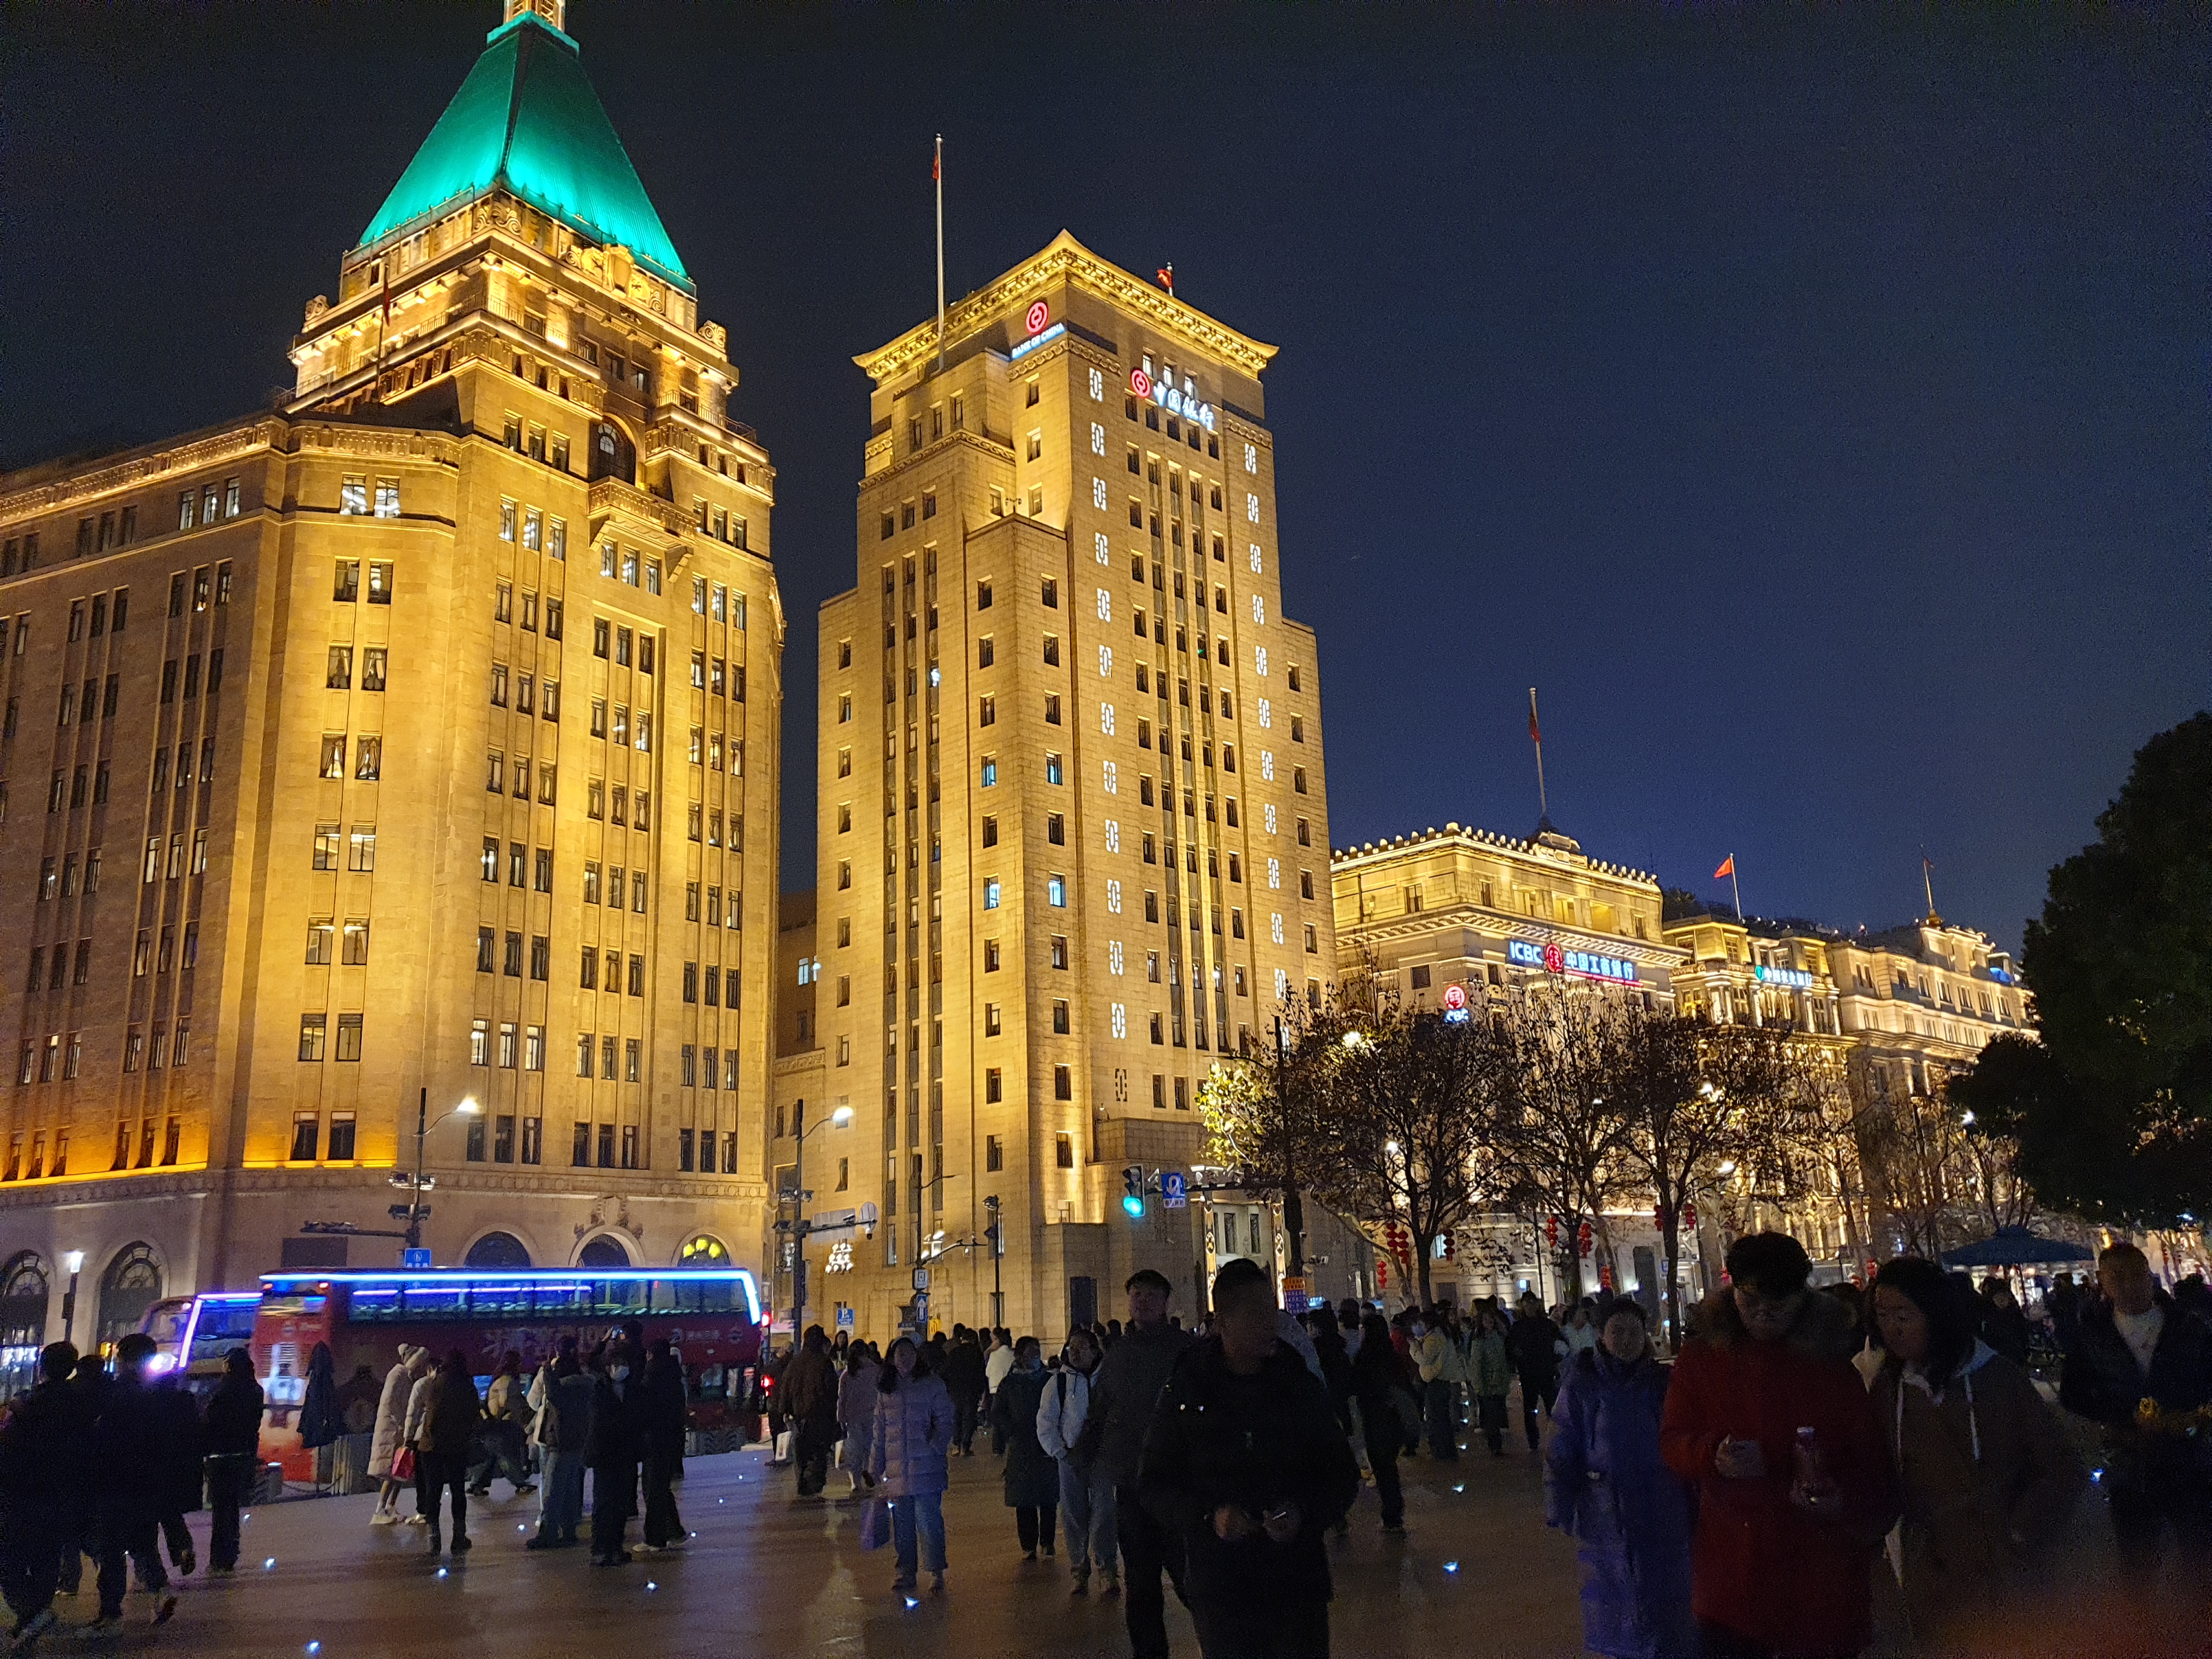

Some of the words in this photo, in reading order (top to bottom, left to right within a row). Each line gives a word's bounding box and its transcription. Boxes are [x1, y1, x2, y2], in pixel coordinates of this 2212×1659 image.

[1012, 340, 1031, 358] BANK
[1031, 335, 1041, 347] OF
[1041, 323, 1065, 342] CHINA
[1509, 941, 1543, 964] ICBC
